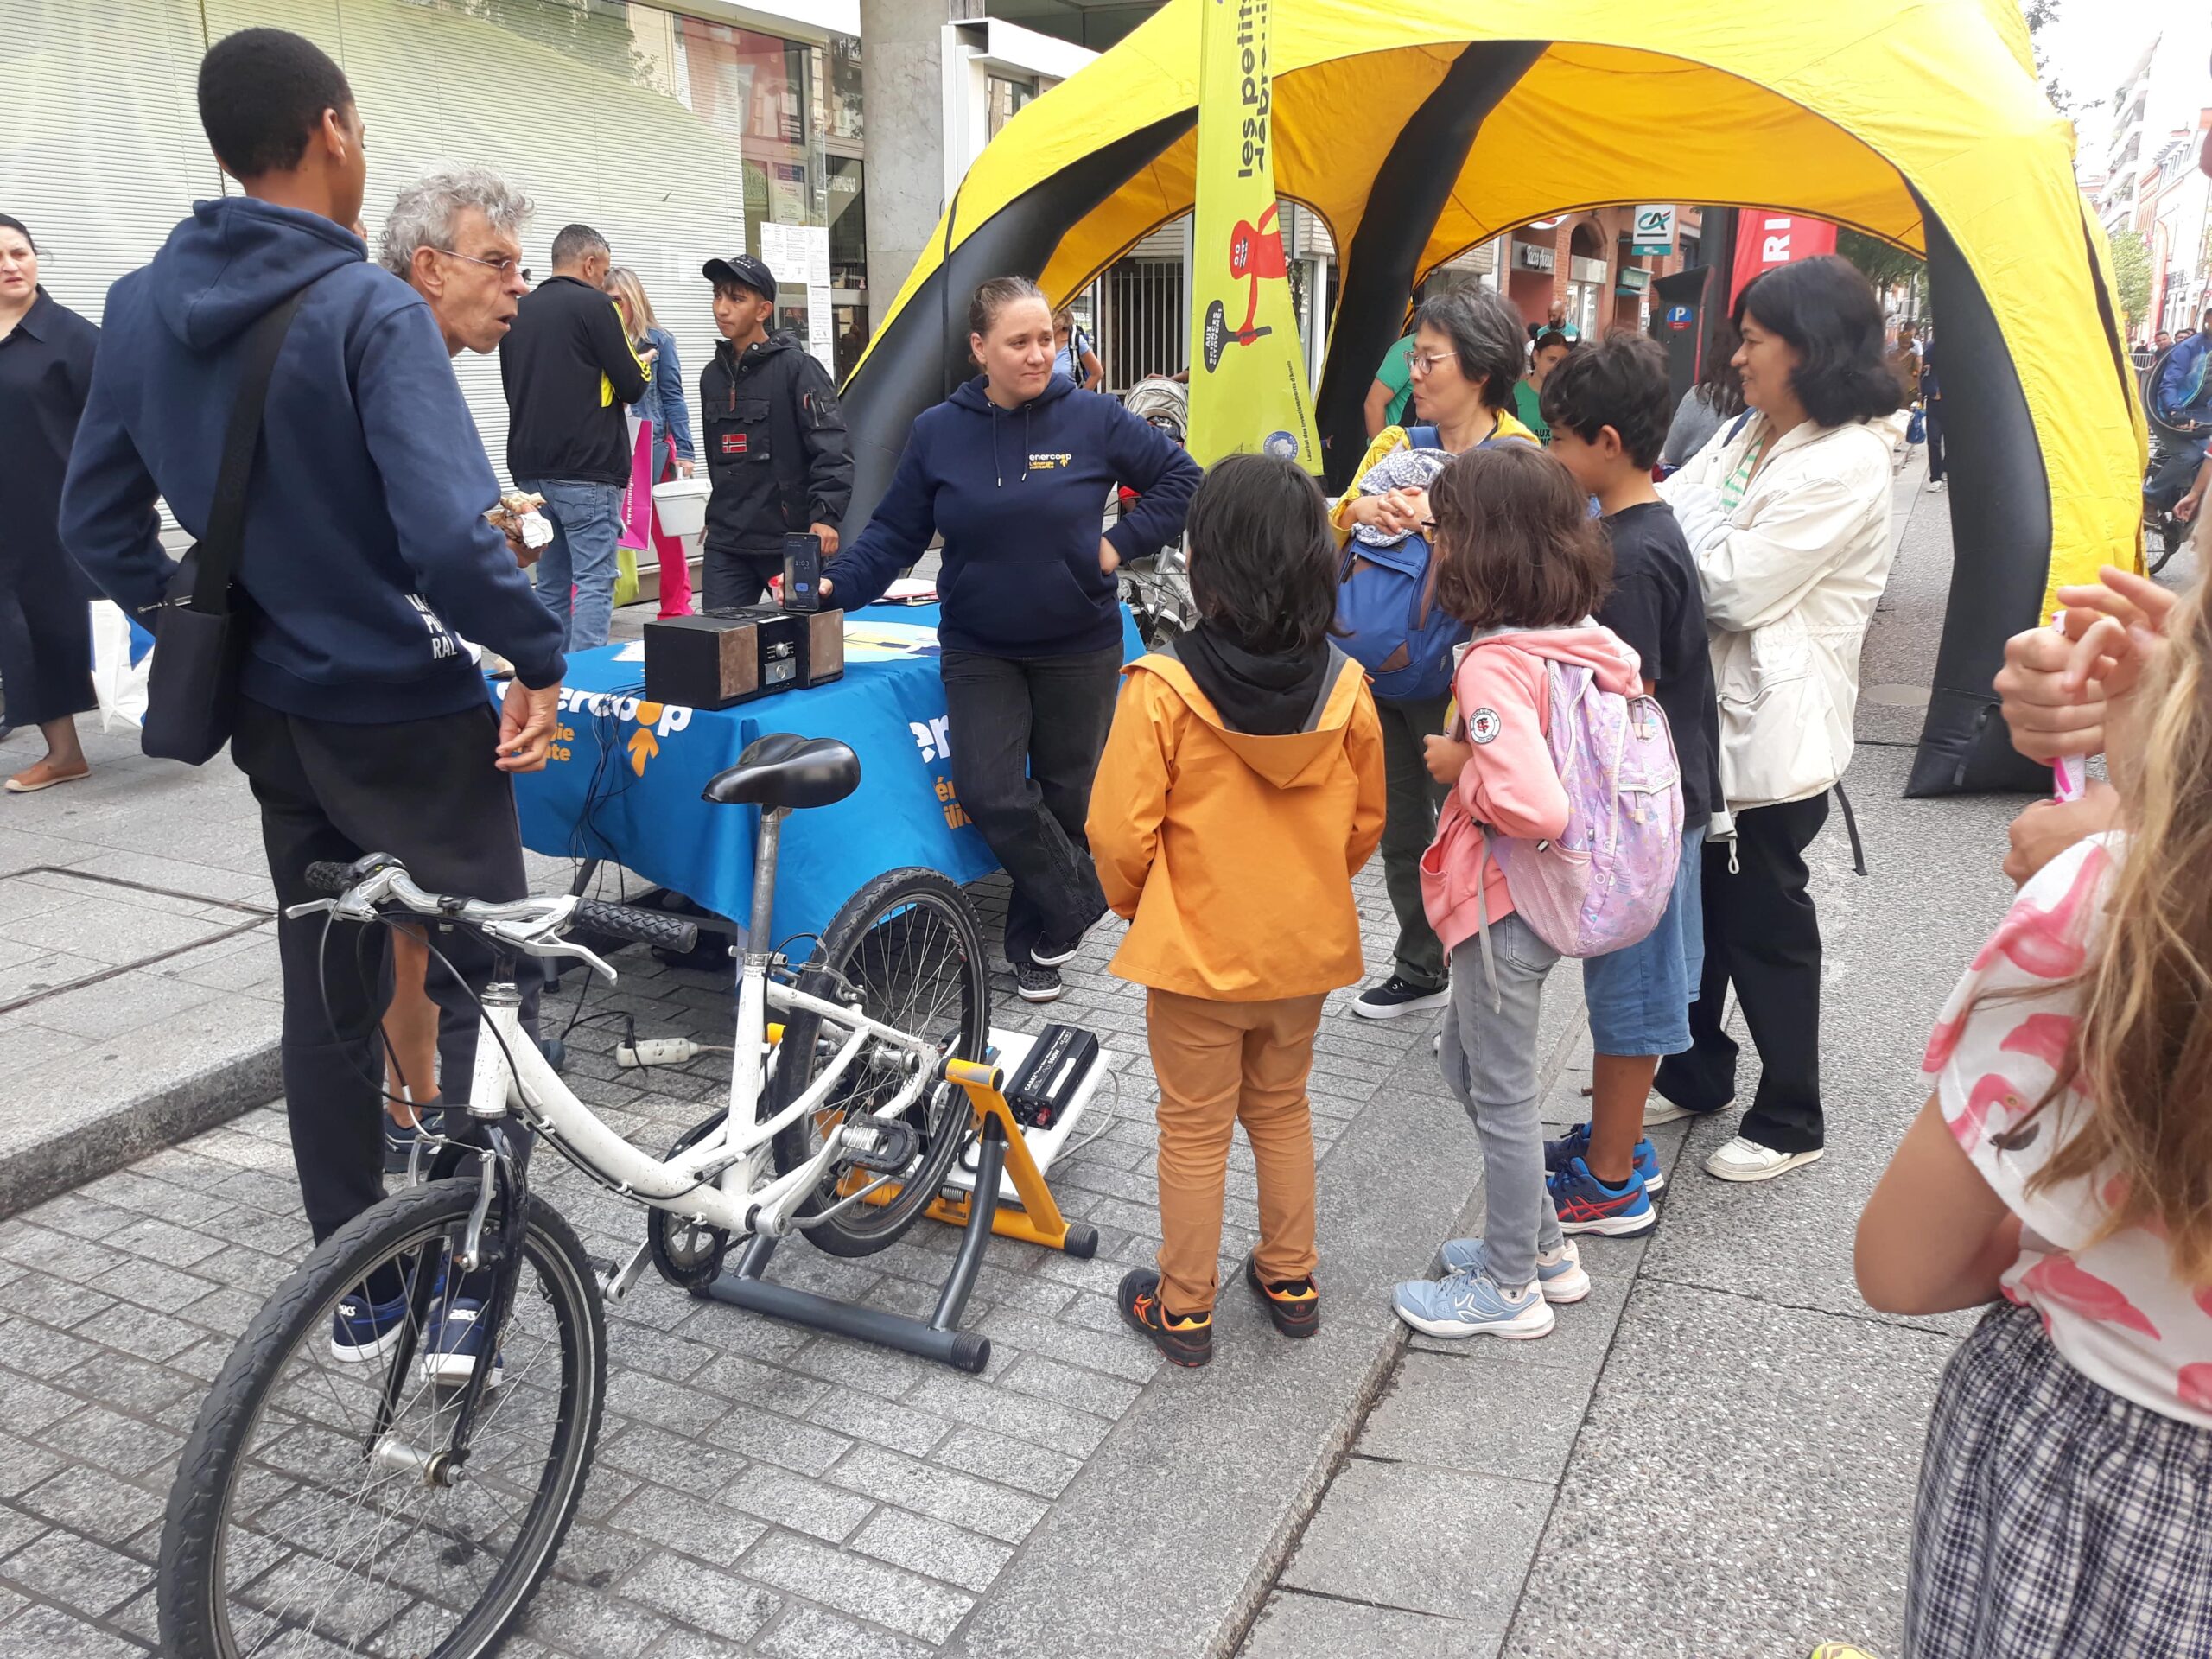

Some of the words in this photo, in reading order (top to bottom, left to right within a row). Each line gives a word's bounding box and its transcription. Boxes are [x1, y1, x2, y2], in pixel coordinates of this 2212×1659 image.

[1237, 0, 1259, 105] petit
[1238, 118, 1255, 178] les
[1675, 307, 1686, 321] P
[1210, 312, 1218, 364] SCIENCES
[432, 635, 458, 659] RAL
[1047, 1048, 1060, 1065] 500W
